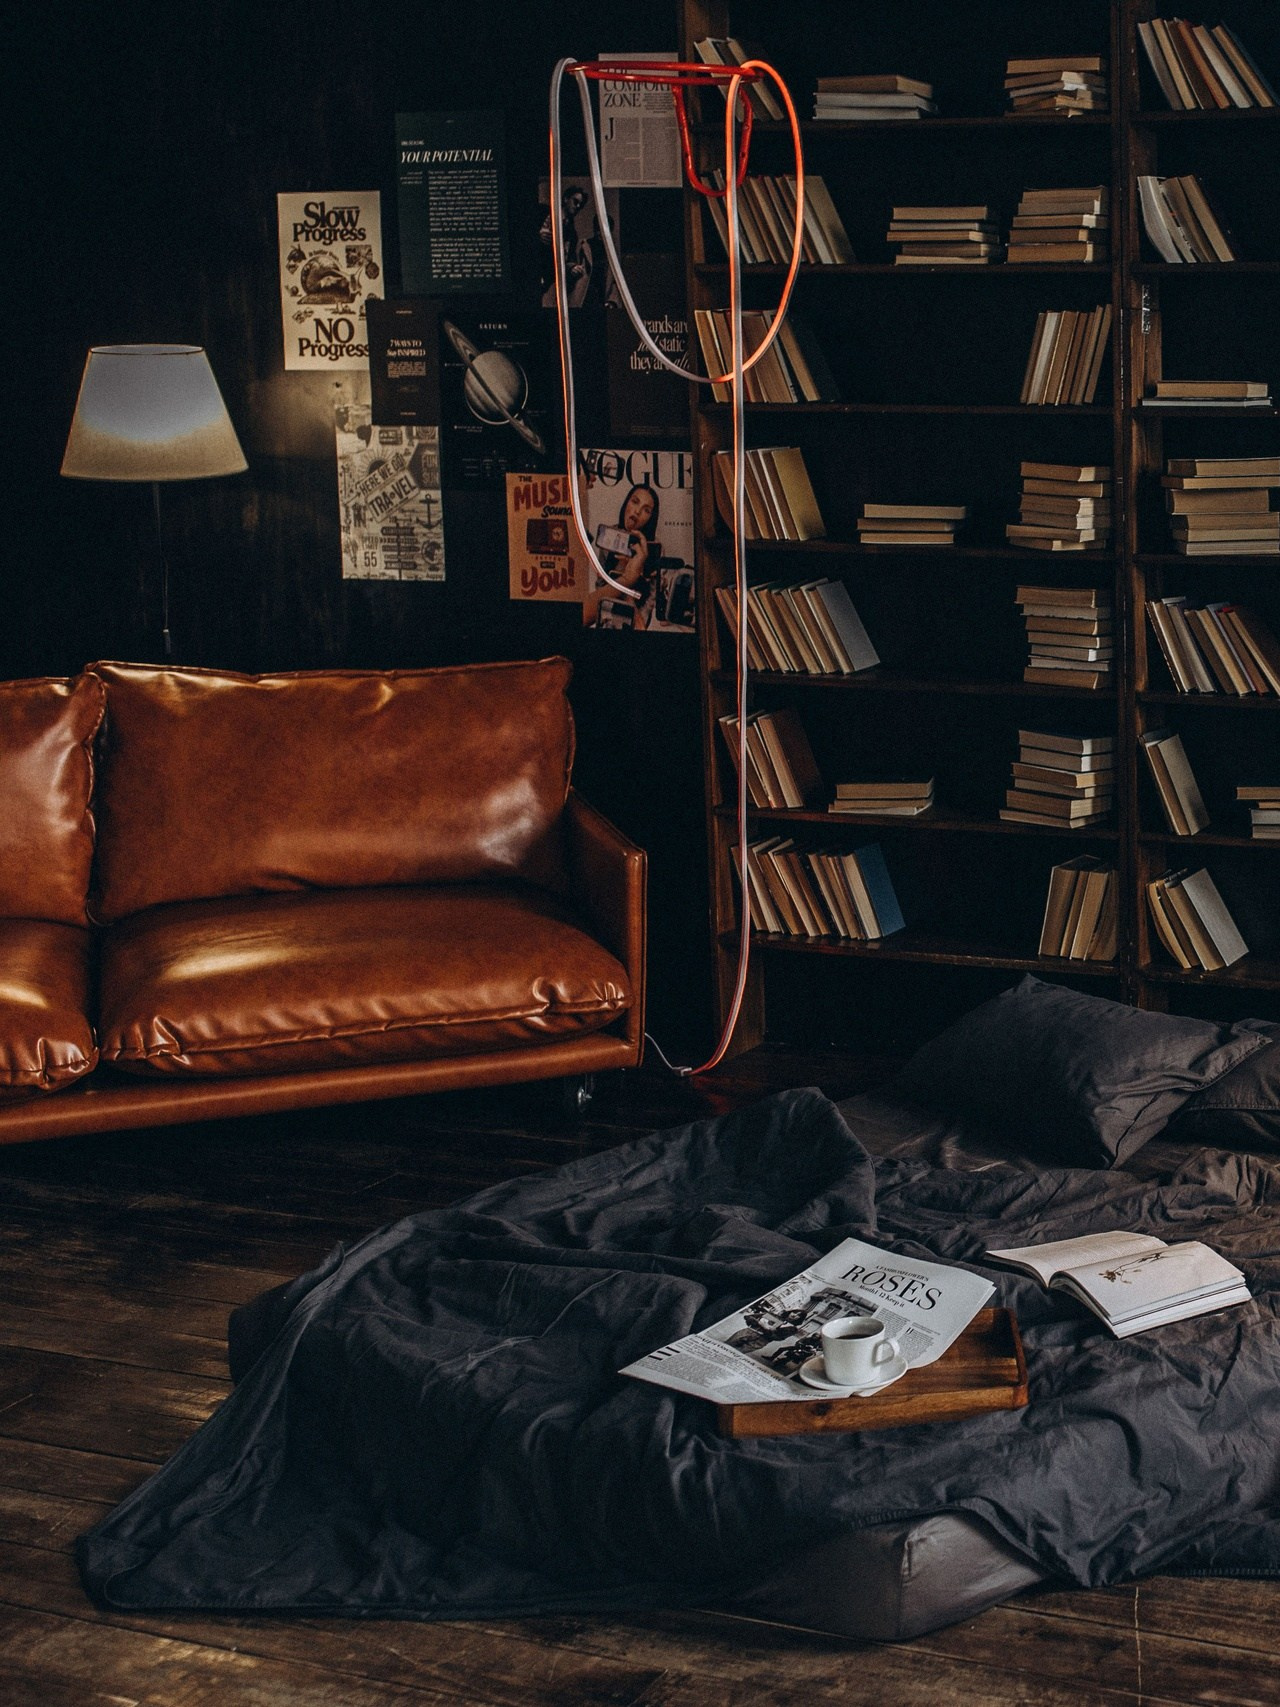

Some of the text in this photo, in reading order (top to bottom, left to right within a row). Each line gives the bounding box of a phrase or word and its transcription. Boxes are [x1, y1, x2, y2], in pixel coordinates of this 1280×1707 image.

[603, 93, 641, 108] ZONE
[401, 149, 494, 164] YOUR POTENTIAL
[304, 201, 360, 228] Slow
[293, 223, 366, 246] Progress
[313, 317, 355, 344] NO
[642, 314, 673, 334] rands
[298, 338, 370, 362] Progress
[630, 350, 651, 375] they
[359, 474, 381, 496] HERE
[379, 464, 393, 480] WE
[580, 449, 694, 489] VOGUE
[514, 478, 569, 512] MUSI
[364, 551, 378, 568] 55
[839, 1264, 942, 1310] ROSES
